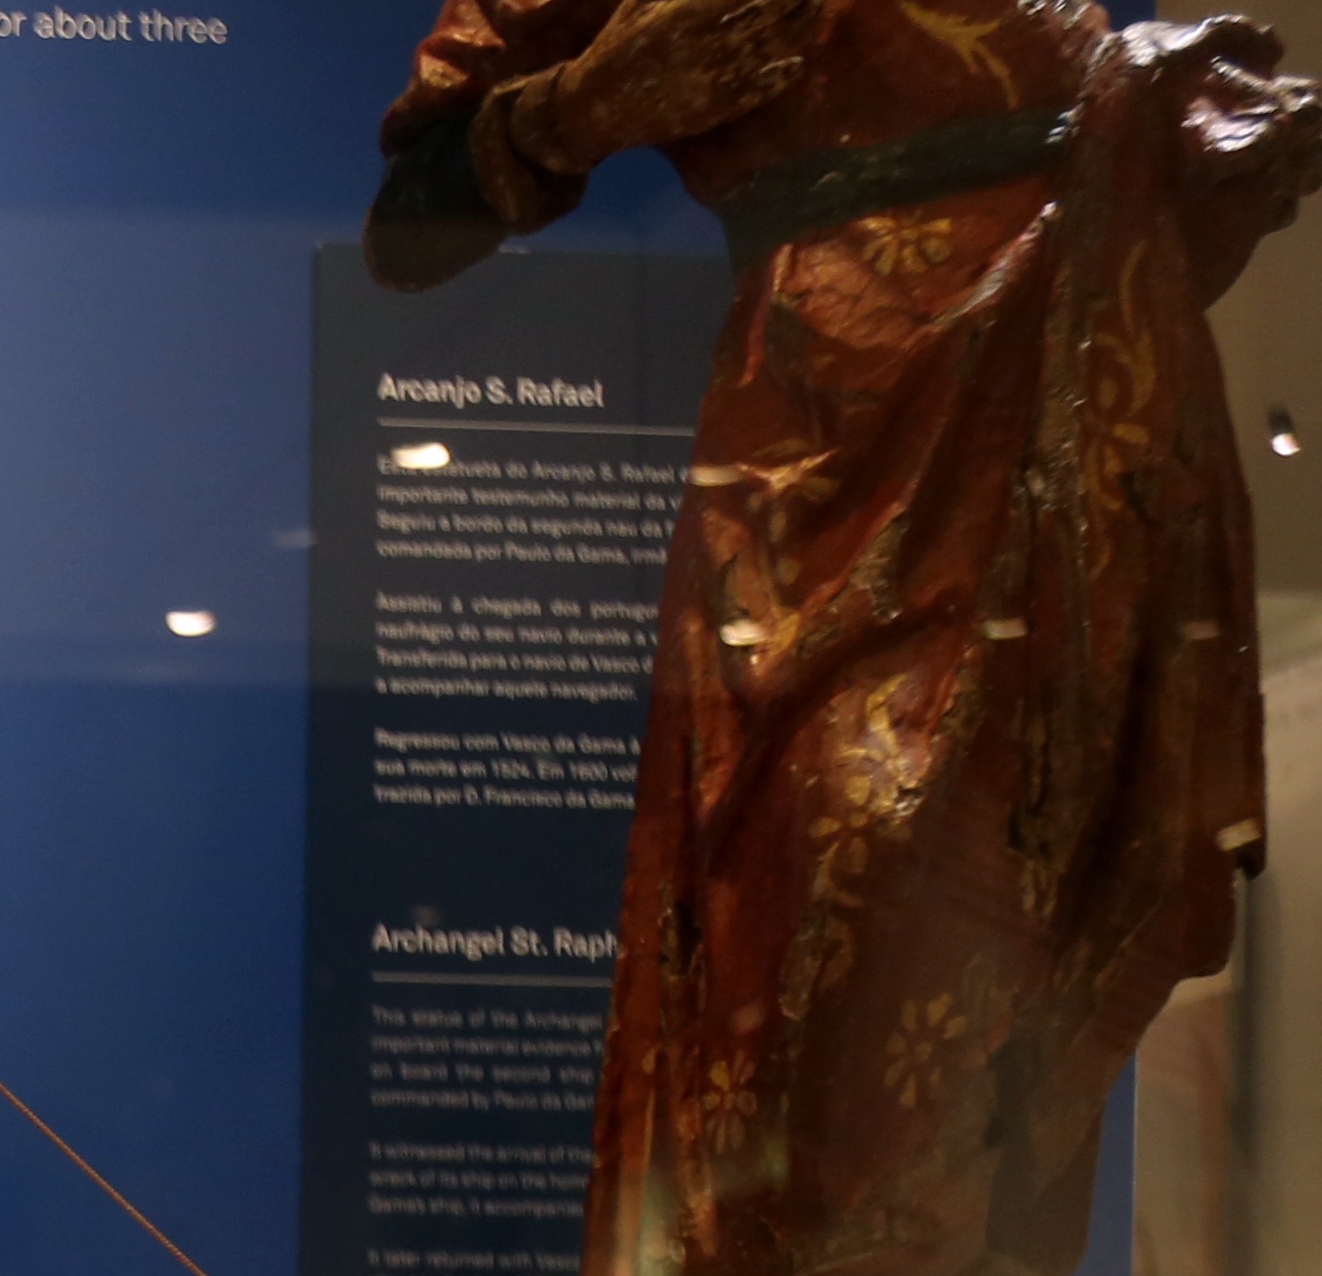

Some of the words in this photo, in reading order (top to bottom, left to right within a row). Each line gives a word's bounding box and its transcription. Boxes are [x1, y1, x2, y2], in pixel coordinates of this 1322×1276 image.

[34, 7, 131, 40] about
[139, 9, 227, 44] three
[378, 374, 481, 408] Arcanjo
[486, 377, 512, 404] S.
[517, 378, 603, 407] Rafael
[372, 924, 504, 960] Archangel
[511, 927, 547, 955] St.
[554, 928, 617, 962] Raph
